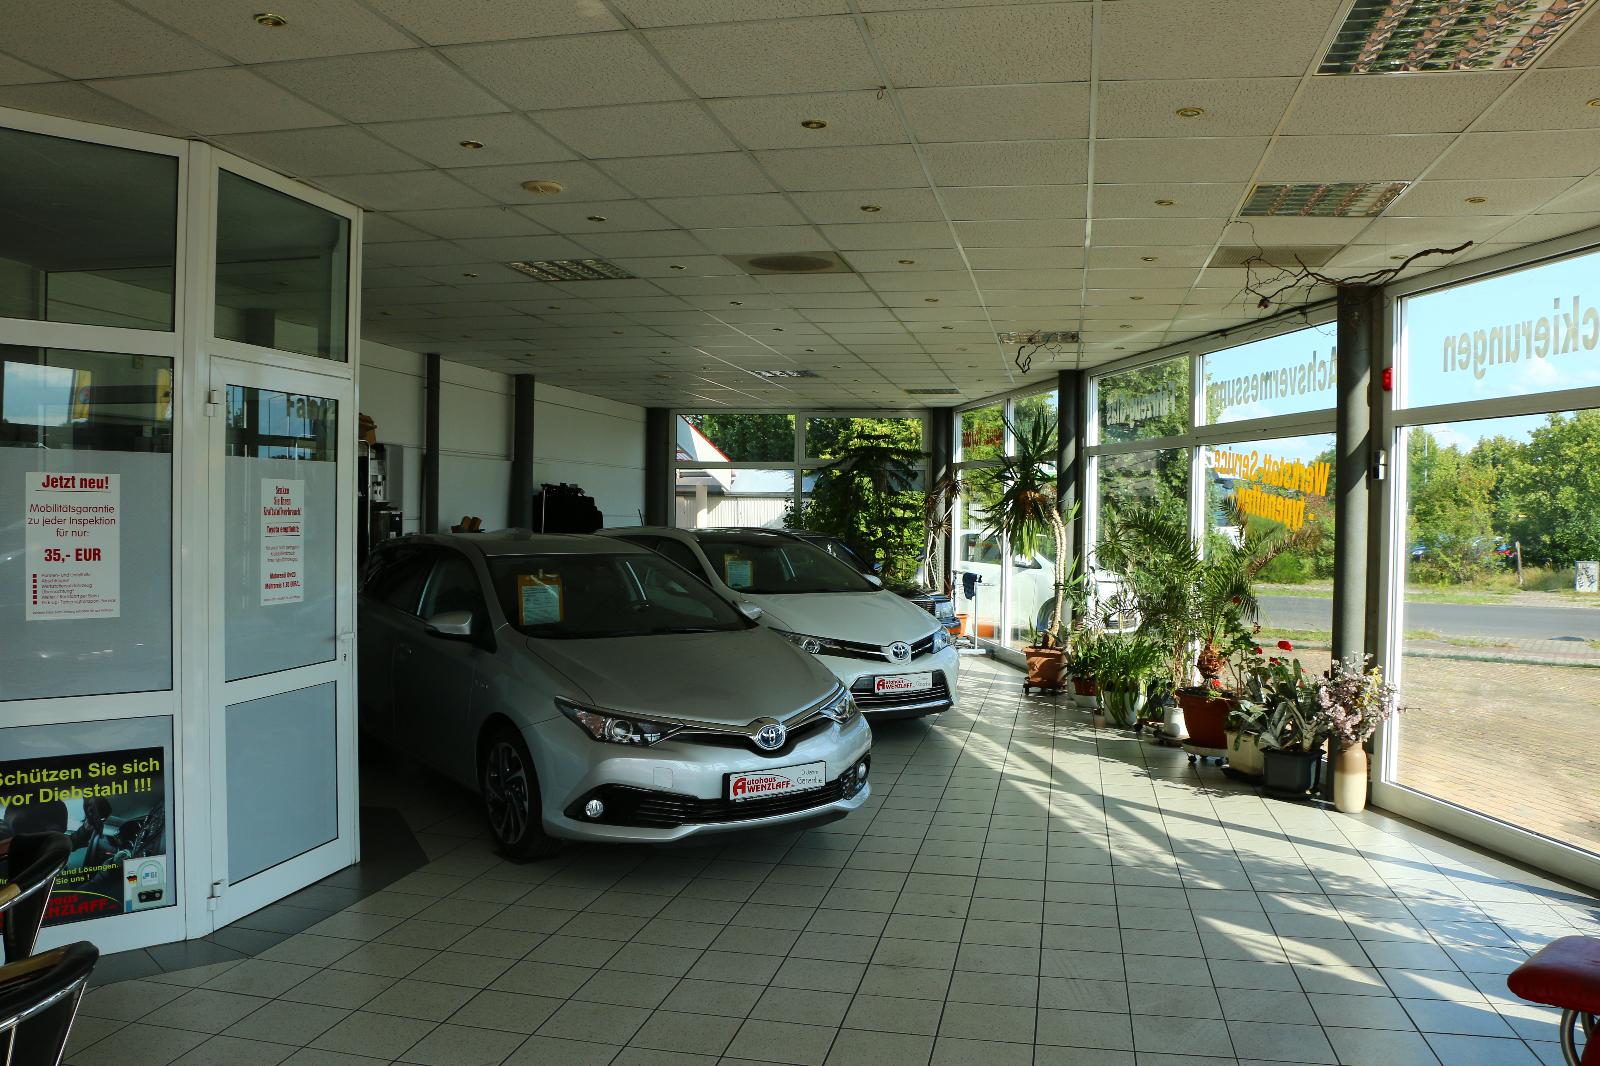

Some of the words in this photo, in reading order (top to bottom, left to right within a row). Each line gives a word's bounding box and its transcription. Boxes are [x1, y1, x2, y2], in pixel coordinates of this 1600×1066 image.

[41, 474, 76, 489] Jetzt
[79, 475, 109, 489] neu!
[29, 503, 115, 515] Mobilitätsgarantie
[27, 517, 40, 525] zu
[42, 516, 67, 527] jeder
[69, 516, 116, 527] Inspektion
[56, 527, 68, 537] für
[71, 529, 89, 537] nur:
[44, 548, 71, 563] 35,-
[75, 548, 101, 562] EUR
[0, 767, 82, 787] chützen
[87, 761, 117, 778] Sie
[122, 757, 160, 774] sich
[0, 792, 34, 808] vor
[39, 779, 128, 804] Diebstahl
[133, 777, 152, 793] !!!
[732, 777, 777, 797] Autohaus
[747, 780, 791, 793] WENZLAFF
[55, 877, 69, 885] Sie
[70, 875, 85, 883] uns
